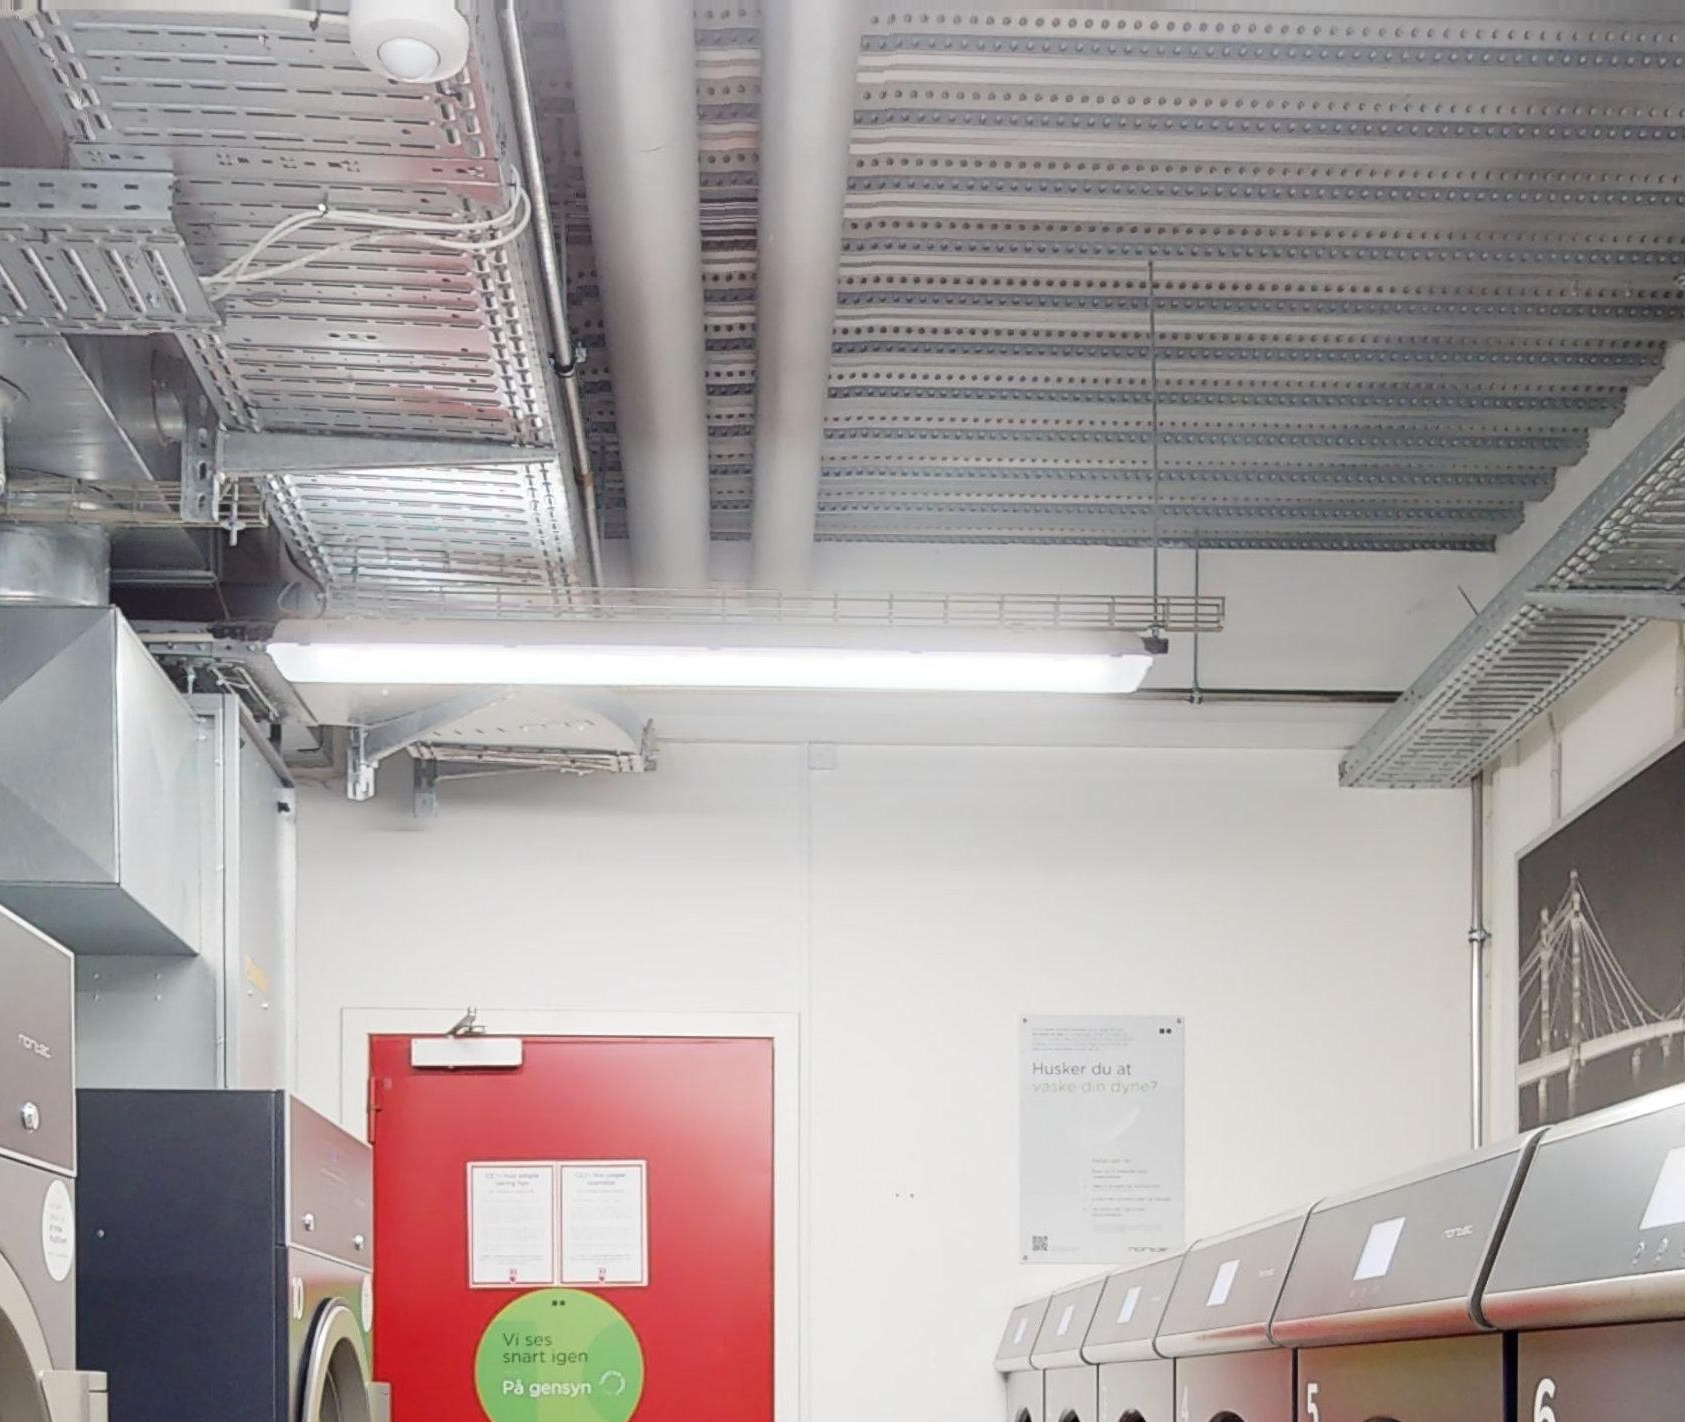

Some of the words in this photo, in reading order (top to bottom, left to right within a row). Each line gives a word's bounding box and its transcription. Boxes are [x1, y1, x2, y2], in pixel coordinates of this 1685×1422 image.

[1032, 1062, 1086, 1076] Husker
[1092, 1062, 1112, 1076] du
[1116, 1063, 1132, 1076] at
[1033, 1080, 1076, 1093] vaske
[1082, 1080, 1106, 1093] din
[1111, 1080, 1158, 1096] dyne?
[503, 1332, 519, 1346] Vi
[525, 1335, 552, 1346] ses
[503, 1350, 546, 1363] snart
[551, 1349, 588, 1366] igen
[503, 1378, 524, 1395] På
[530, 1381, 592, 1398] gensyn
